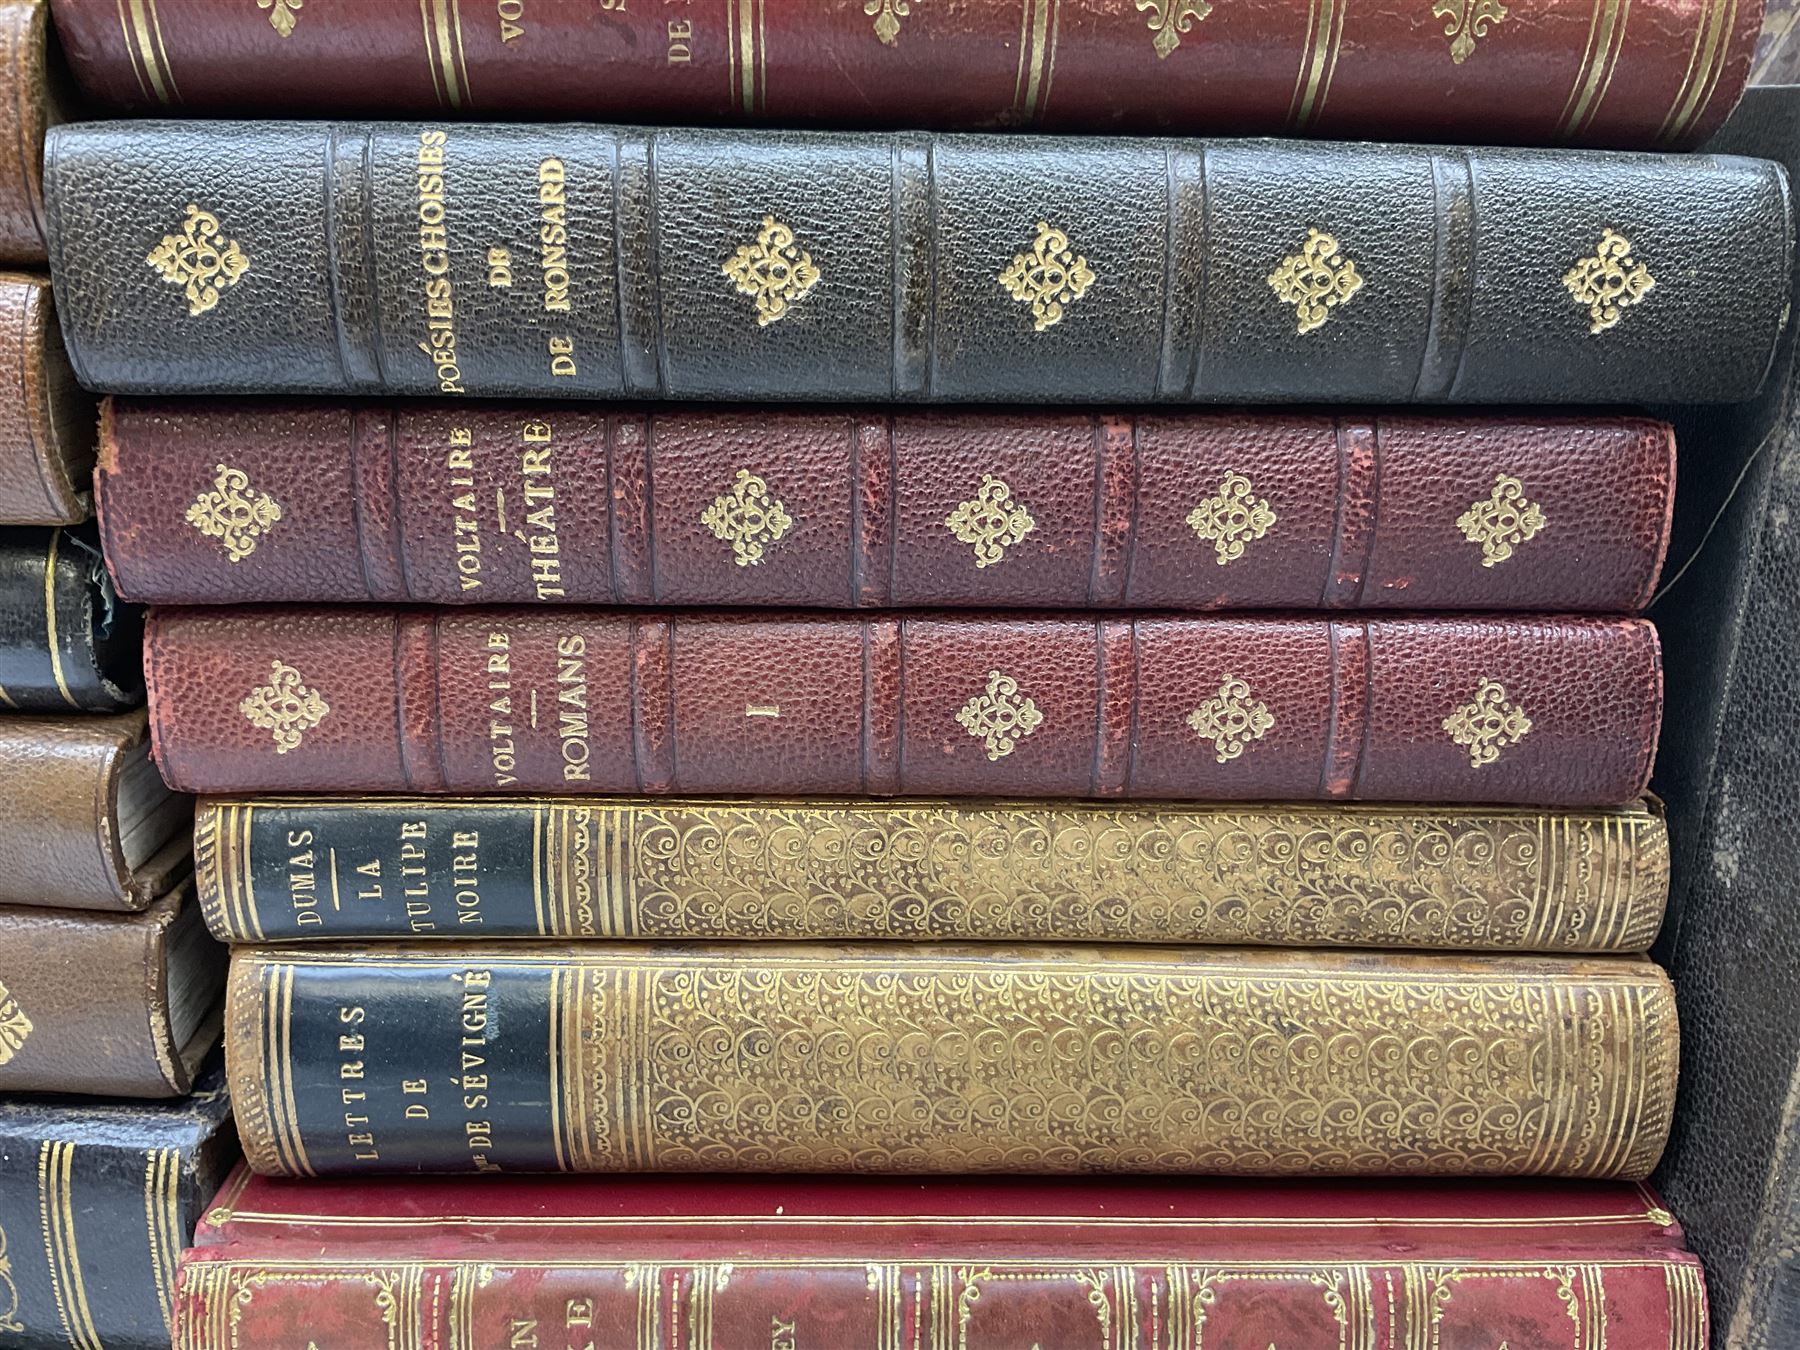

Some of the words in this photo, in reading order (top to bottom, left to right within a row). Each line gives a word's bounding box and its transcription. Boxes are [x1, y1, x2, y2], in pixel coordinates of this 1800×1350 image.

[667, 20, 692, 66] DE
[418, 130, 449, 275] CHOISIES
[539, 157, 571, 311] RONSARD
[418, 278, 464, 393] POÉSIES
[549, 335, 577, 376] DE
[449, 427, 483, 591] VOLTAIRE
[514, 422, 565, 600] THÉATRE
[487, 631, 519, 786] VOLTAIRE
[557, 635, 590, 781] ROMANS
[288, 830, 322, 926] DUMAS
[356, 859, 383, 899] LA
[401, 820, 435, 932] TULIPE
[452, 831, 483, 924] NOIRE
[339, 1007, 380, 1160] LETTRES
[450, 970, 492, 1109] SÉVIGNÉ
[402, 1079, 429, 1119] DE
[465, 1121, 492, 1149] DE
